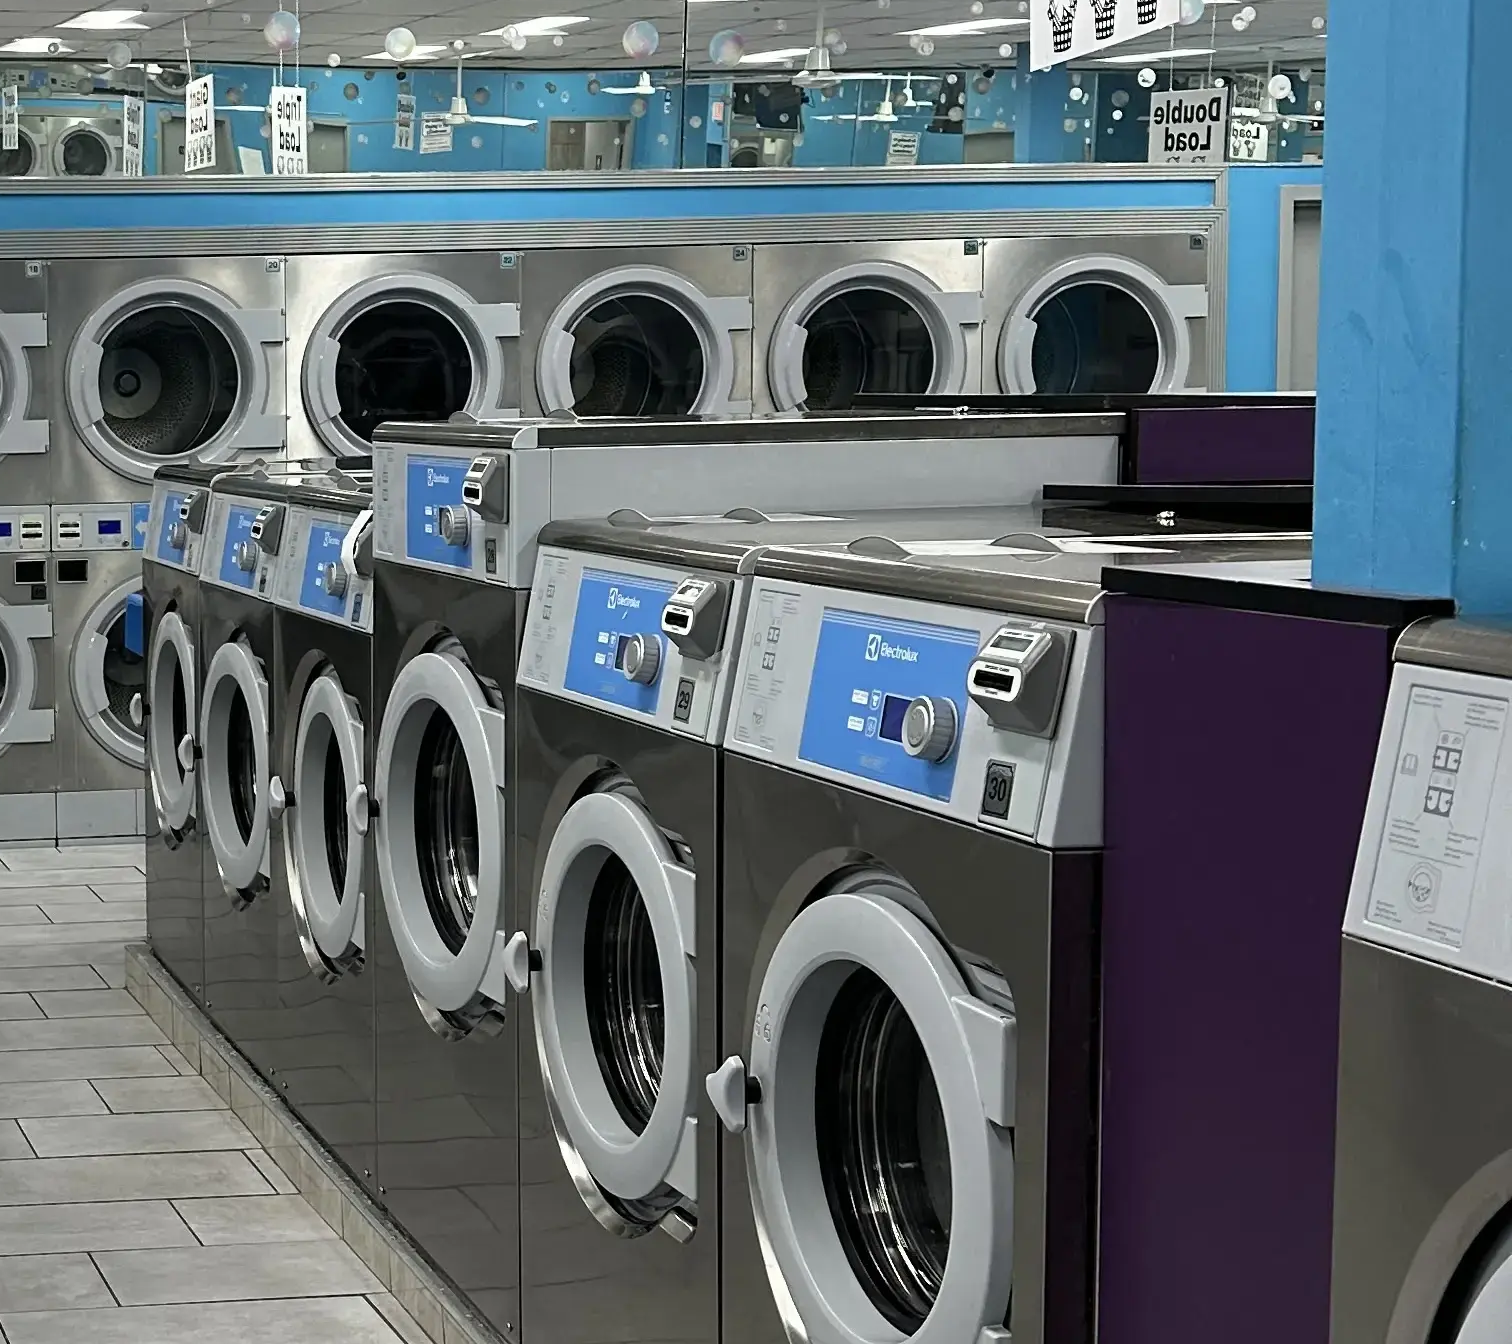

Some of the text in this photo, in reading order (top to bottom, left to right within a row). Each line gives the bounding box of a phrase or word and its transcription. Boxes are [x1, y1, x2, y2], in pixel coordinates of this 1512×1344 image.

[268, 261, 278, 269] 20
[503, 256, 513, 264] 22
[880, 641, 919, 662] Electrolux
[988, 777, 1006, 802] 30
